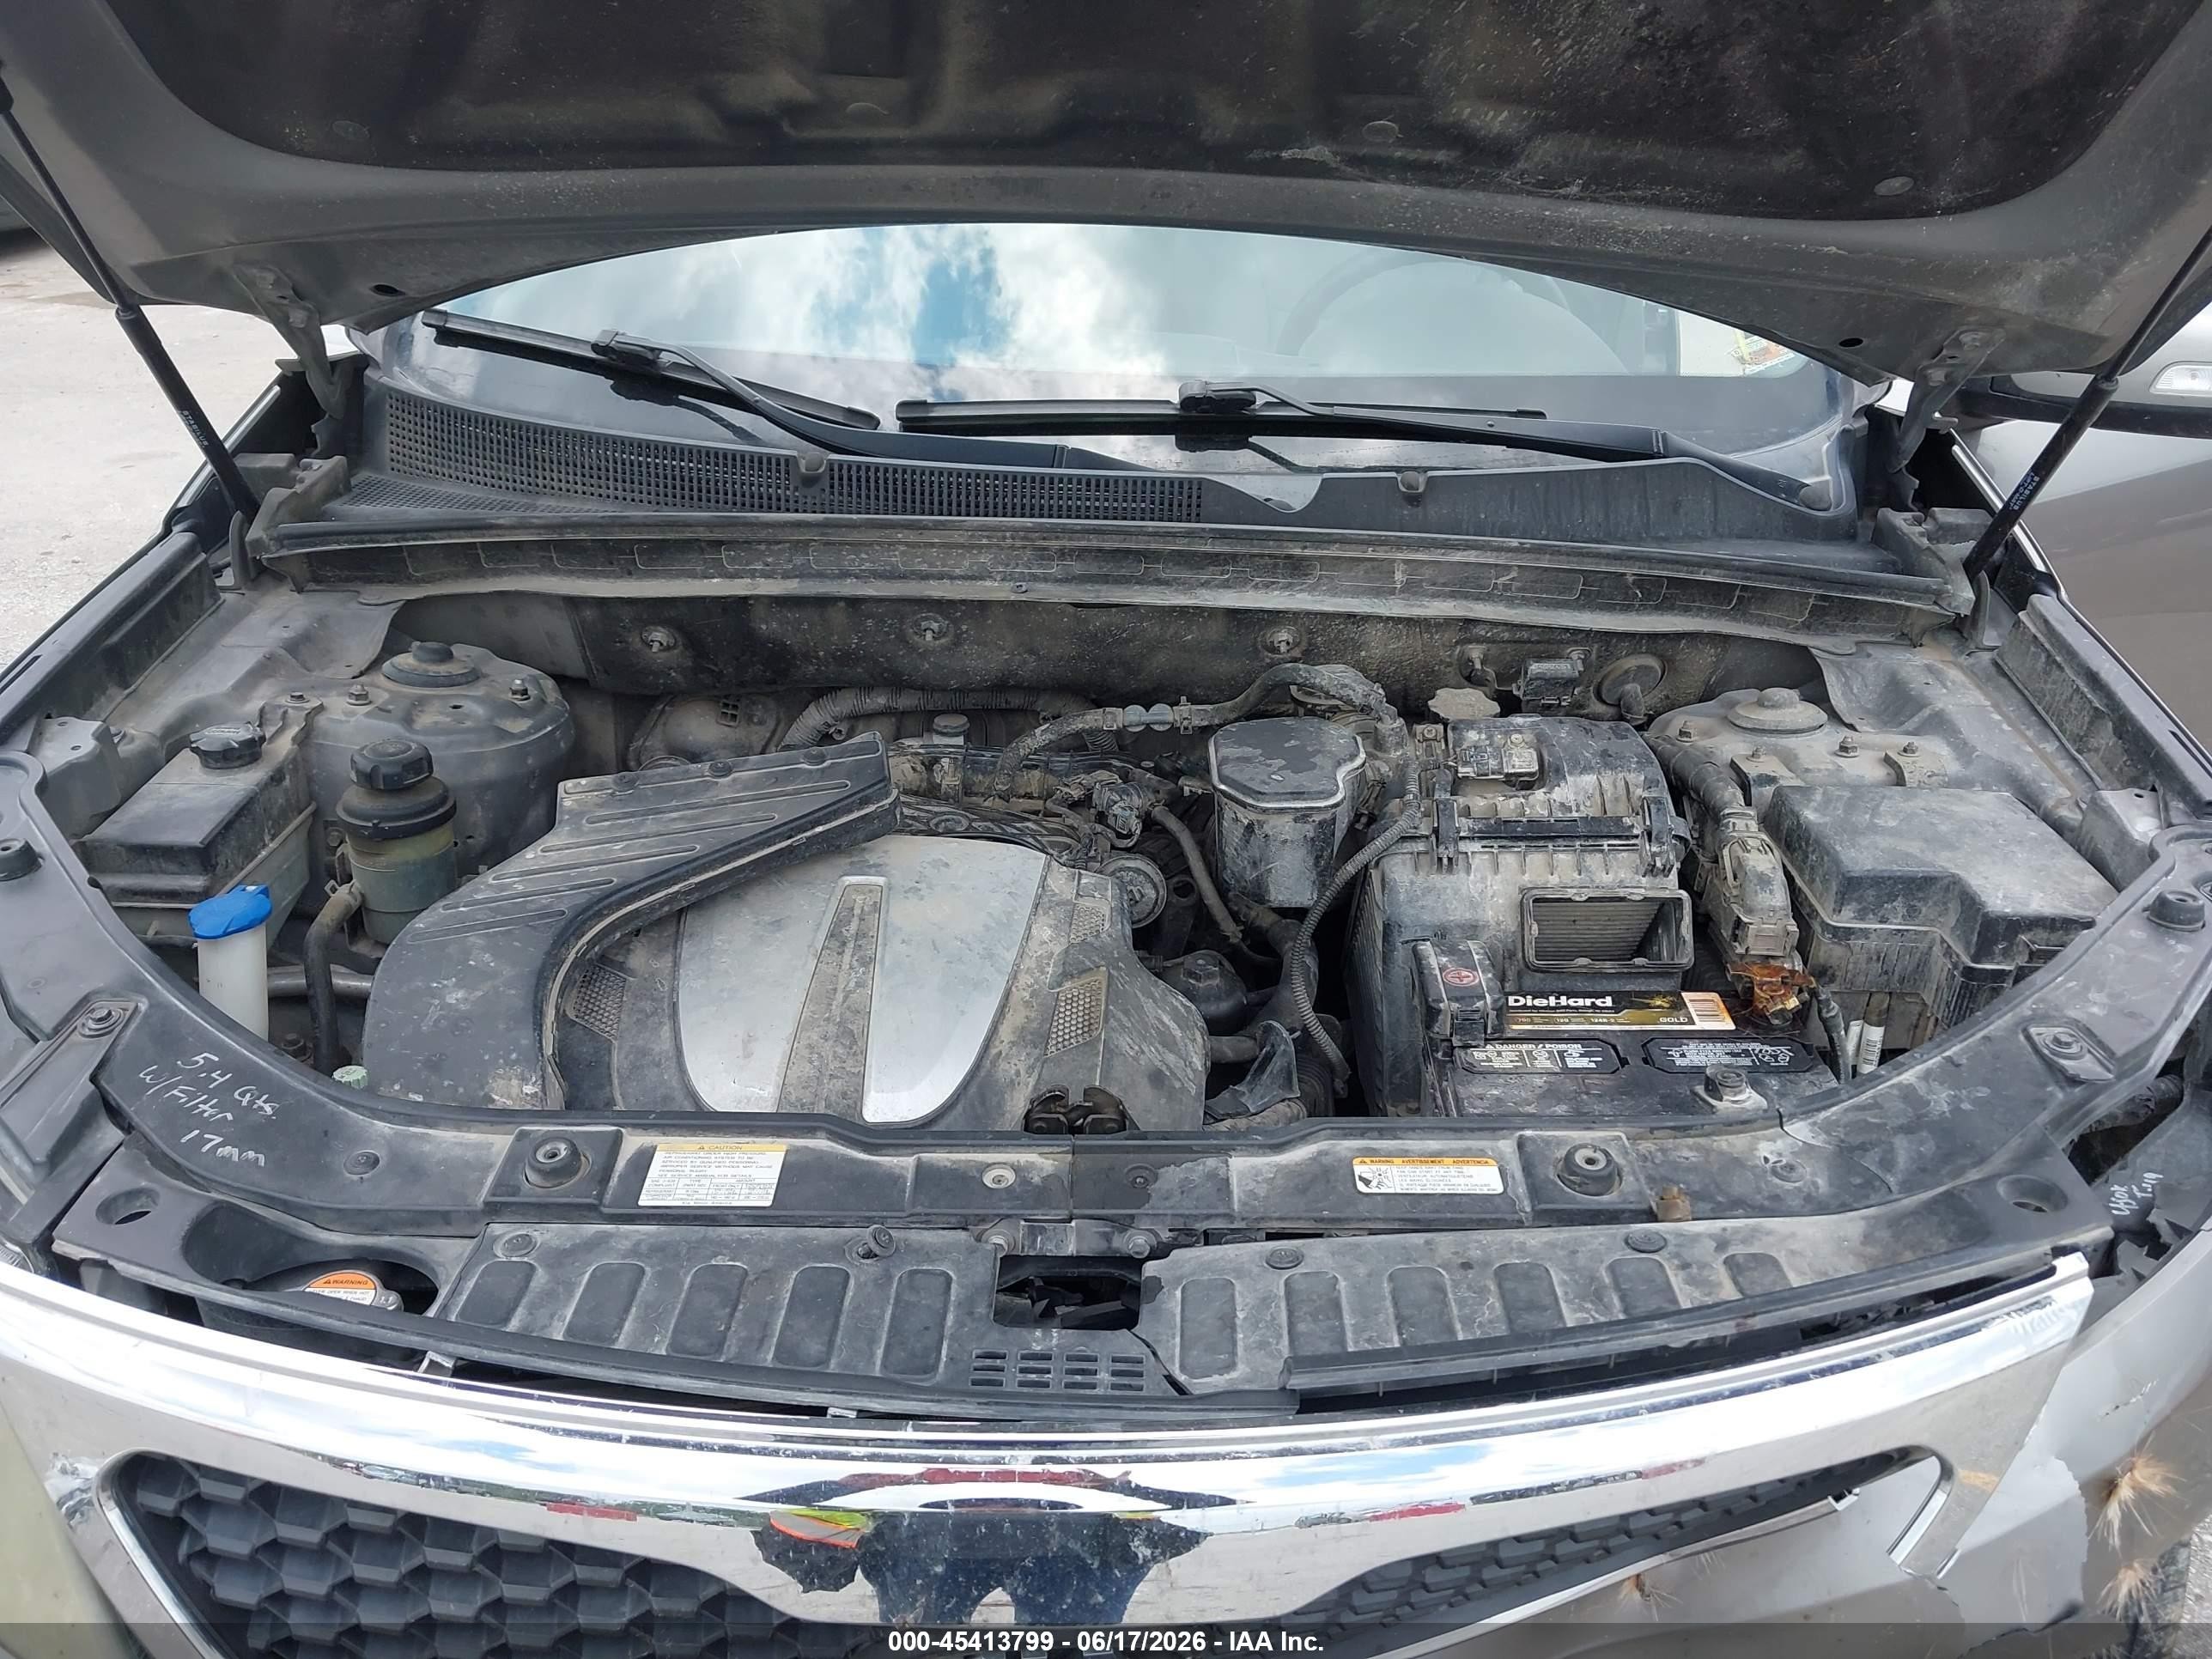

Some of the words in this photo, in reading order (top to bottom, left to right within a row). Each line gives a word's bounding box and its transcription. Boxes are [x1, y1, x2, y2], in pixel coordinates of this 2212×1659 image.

[2013, 475, 2040, 510] STABILUS
[1508, 995, 1613, 1006] DieHard
[177, 1053, 233, 1089] 5.4
